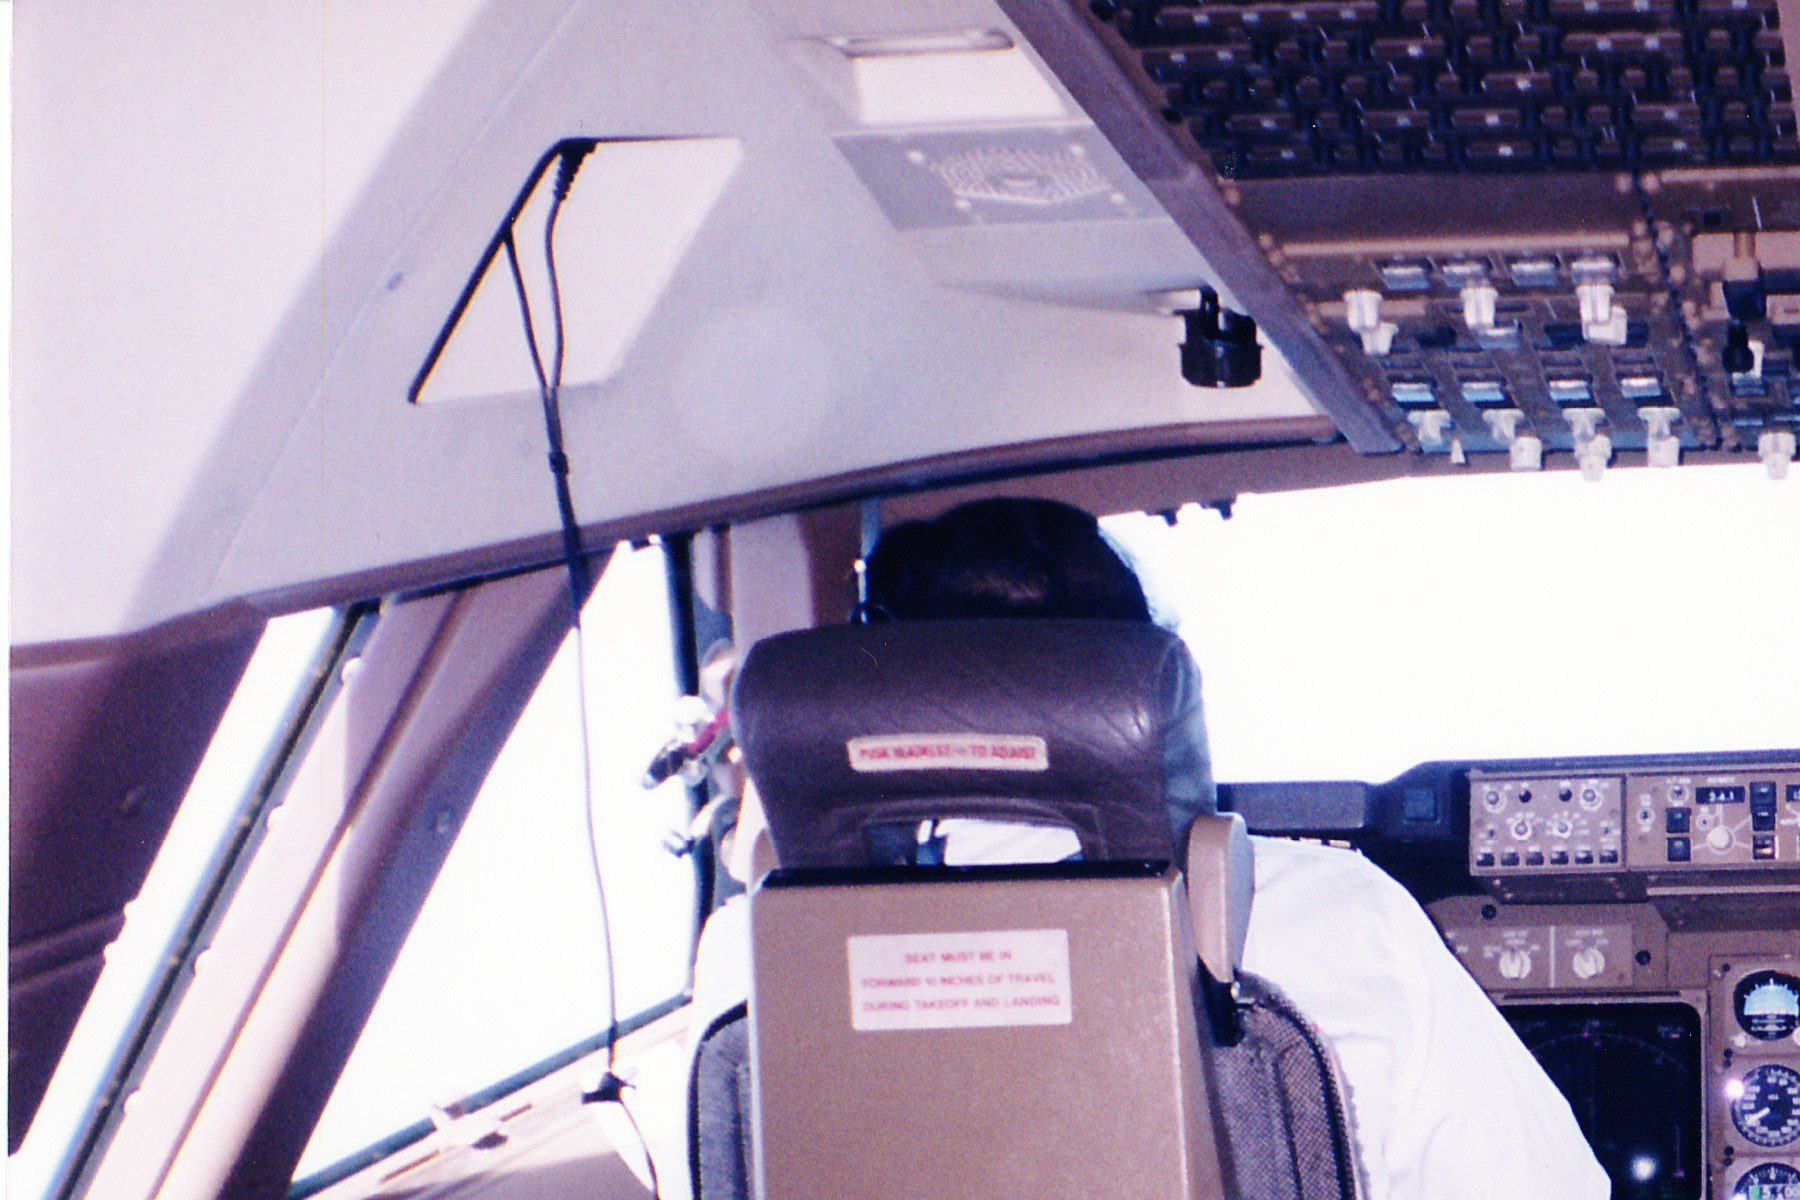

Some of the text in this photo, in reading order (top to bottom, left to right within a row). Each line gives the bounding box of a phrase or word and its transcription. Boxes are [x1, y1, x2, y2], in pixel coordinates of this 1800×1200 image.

[905, 952, 936, 963] SEAT
[941, 951, 975, 962] MUST
[862, 976, 921, 987] FORWARD
[1008, 972, 1055, 984] TRAVEL
[914, 998, 968, 1010] TAKEOFF
[974, 997, 1000, 1007] AND
[1004, 995, 1060, 1007] LANDING
